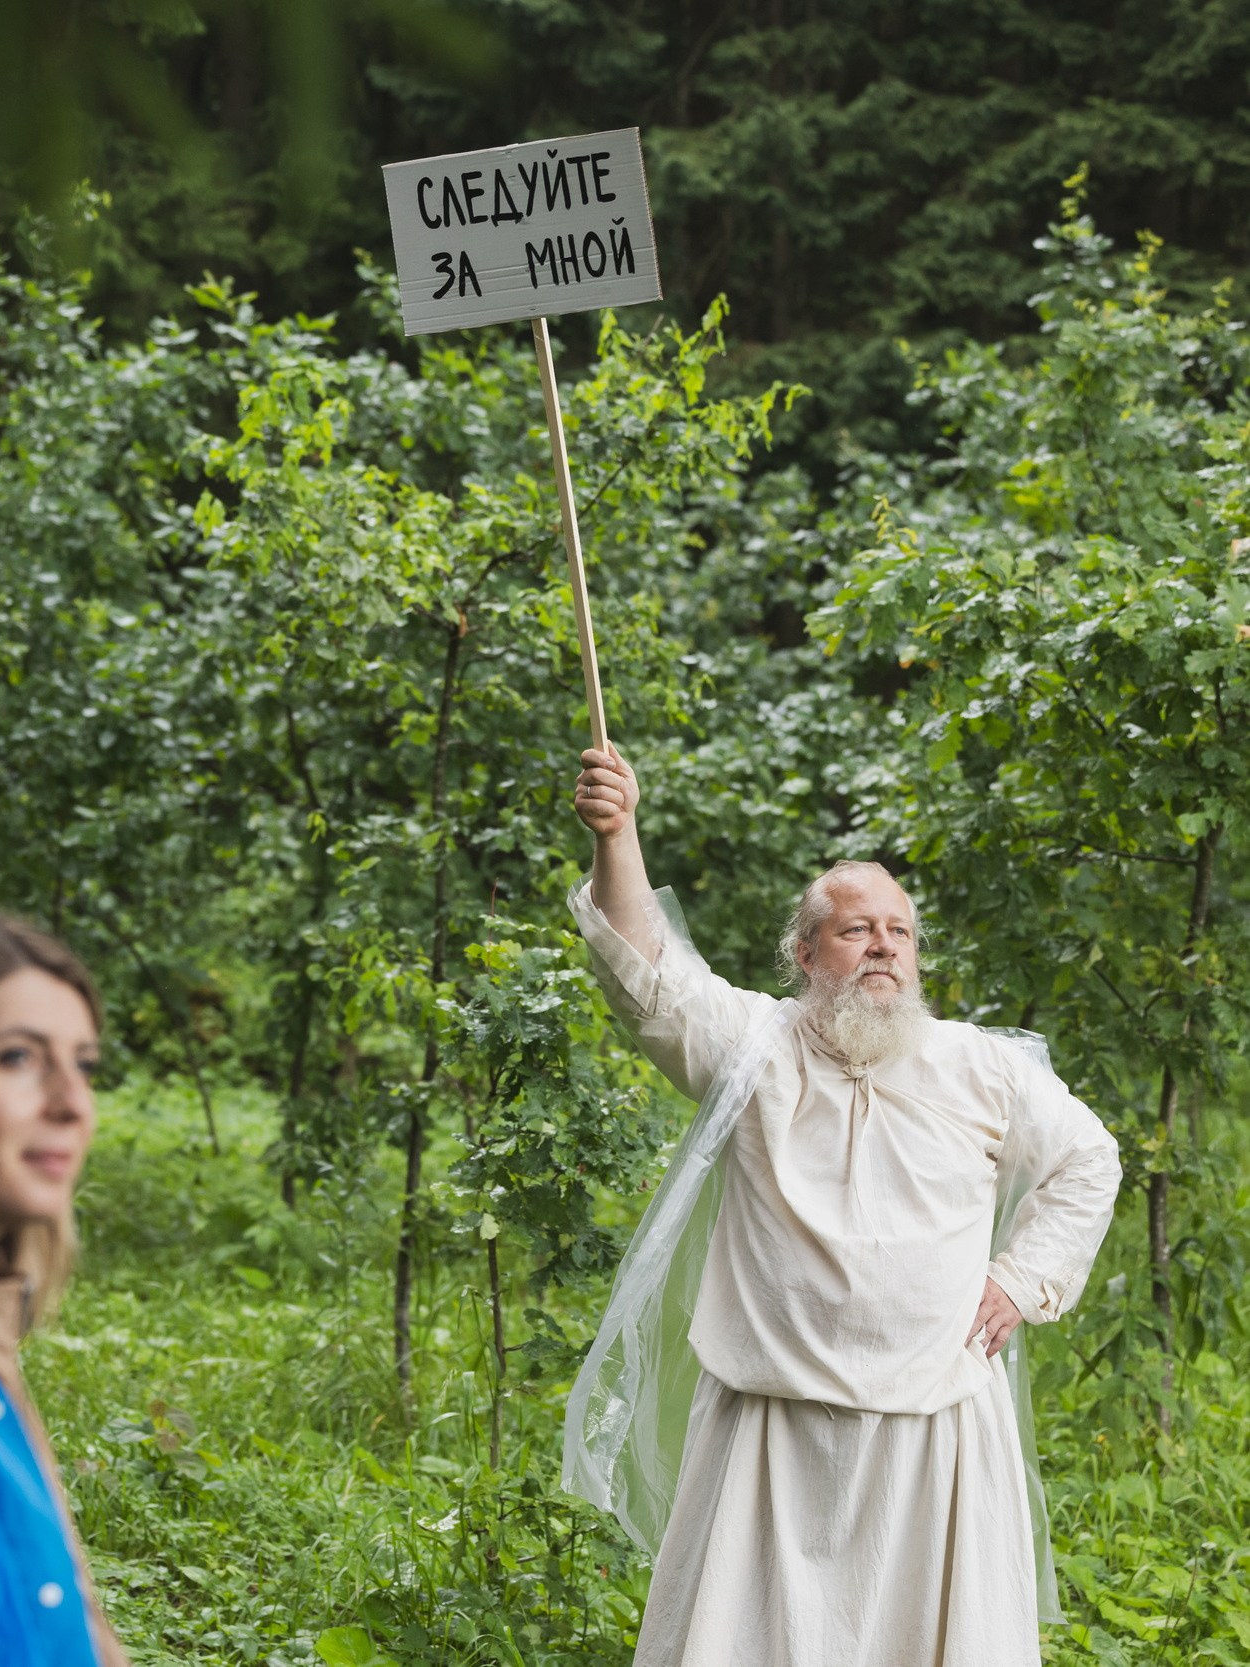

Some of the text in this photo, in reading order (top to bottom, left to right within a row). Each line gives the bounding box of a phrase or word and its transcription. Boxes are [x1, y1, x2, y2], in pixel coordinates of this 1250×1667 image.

[417, 149, 616, 229] СЛЕДУЙТЕ
[431, 217, 635, 300] ЗА МНОЙ
